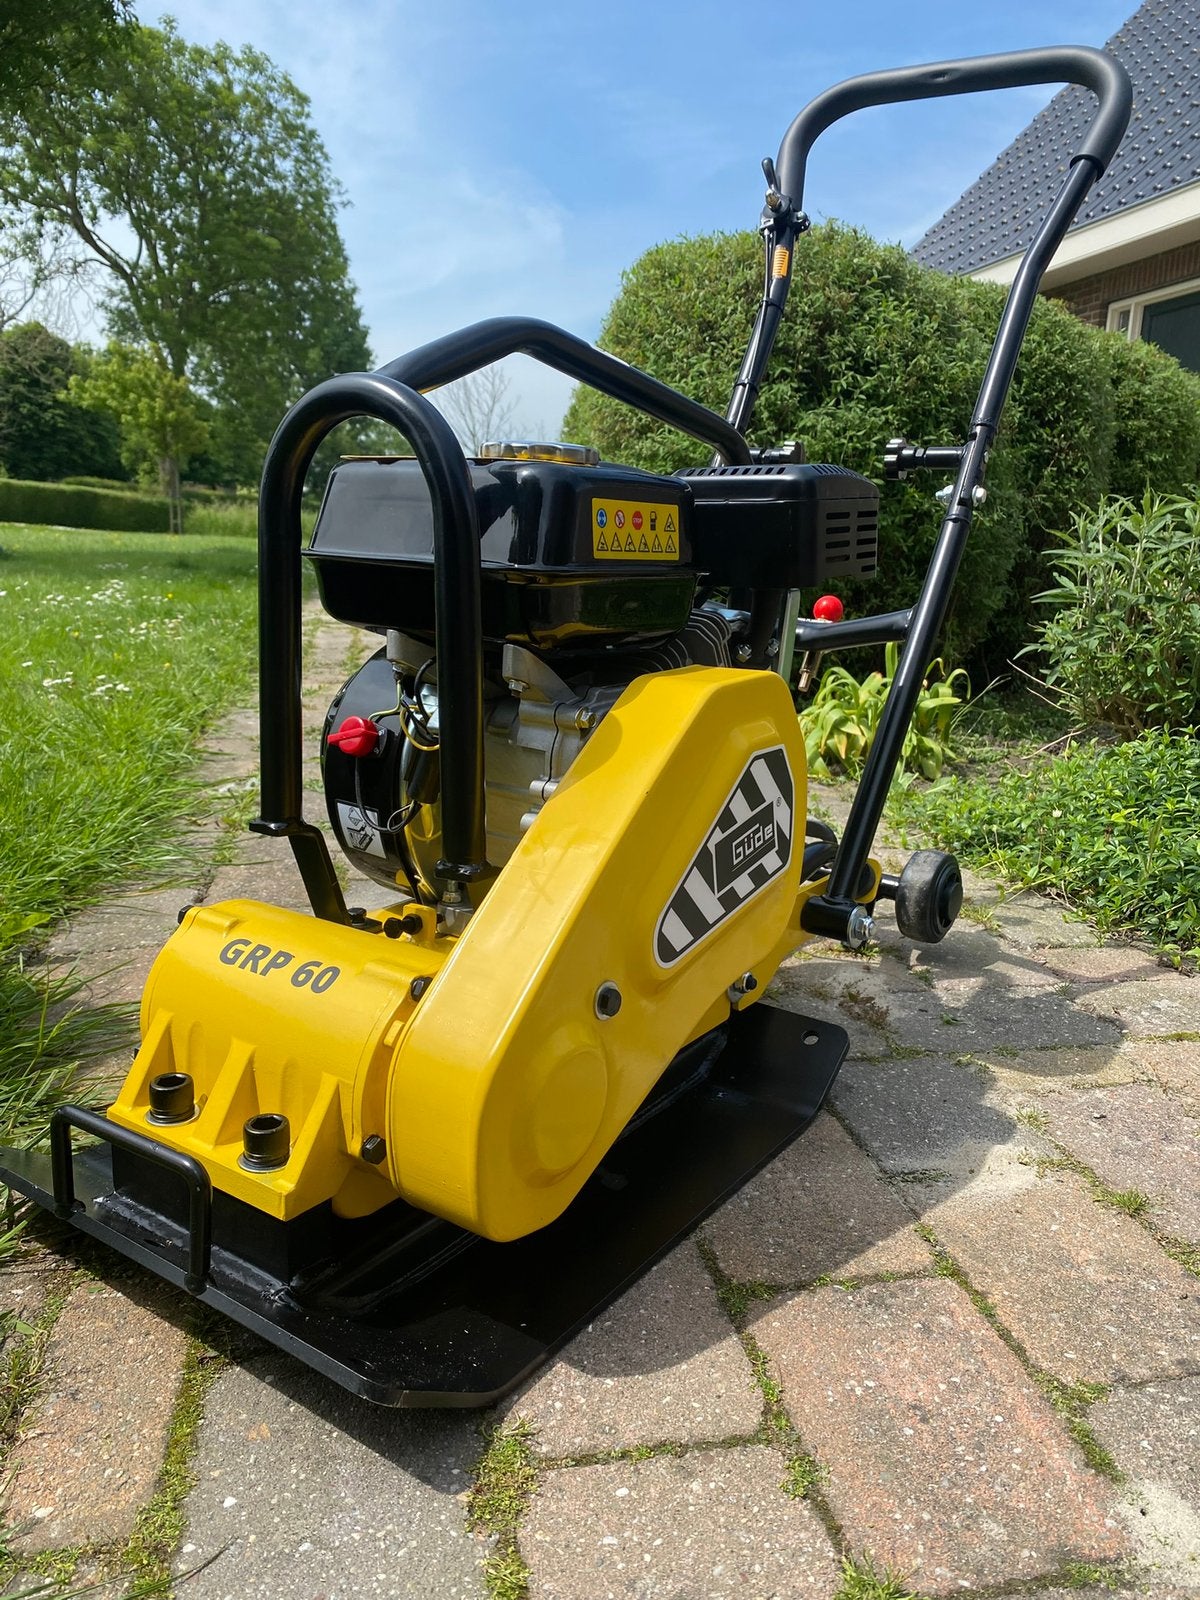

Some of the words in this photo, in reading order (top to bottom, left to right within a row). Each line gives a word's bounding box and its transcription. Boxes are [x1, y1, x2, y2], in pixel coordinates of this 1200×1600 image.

[732, 823, 774, 866] Güde
[219, 938, 294, 977] GRP
[290, 960, 341, 994] 60
